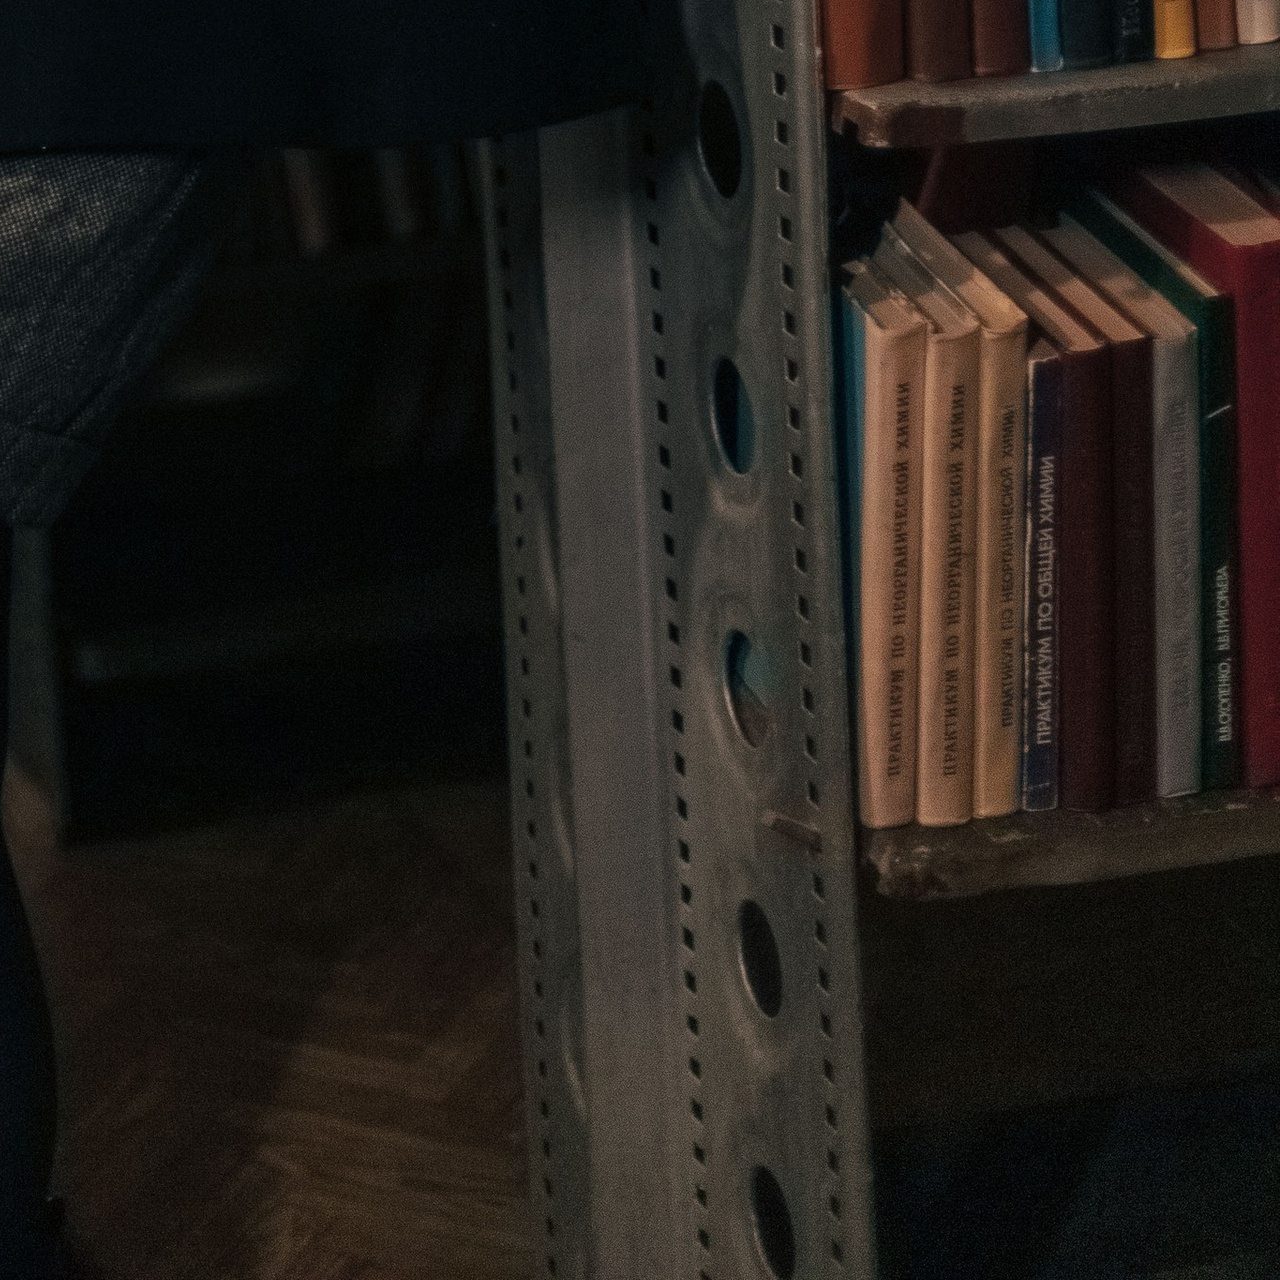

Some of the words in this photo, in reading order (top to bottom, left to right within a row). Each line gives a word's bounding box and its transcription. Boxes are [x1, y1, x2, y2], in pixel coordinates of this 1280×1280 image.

[895, 381, 911, 450] ХИМИИ
[948, 384, 966, 452] ХИМИИ
[1038, 454, 1056, 523] ХИМИИ
[892, 460, 910, 626] НЕОРГАНИЧЕСКОЙ
[944, 461, 964, 626] НЕОРГАНИЧЕСКОЙ
[998, 465, 1015, 603] НЕОРГАНИЧЕСКОЙ
[1035, 527, 1057, 598] ОБЩЕЙ
[891, 634, 906, 659] ПО
[946, 635, 961, 658] ПО
[999, 608, 1014, 631] ПО
[1037, 602, 1054, 631] ПО
[999, 637, 1015, 728] ПРАКТИКУМ
[1036, 637, 1053, 745] ПРАКТИКУМ
[886, 668, 905, 778] ПРАКТИКУМ
[942, 667, 960, 777] ПРАКТИКУМ
